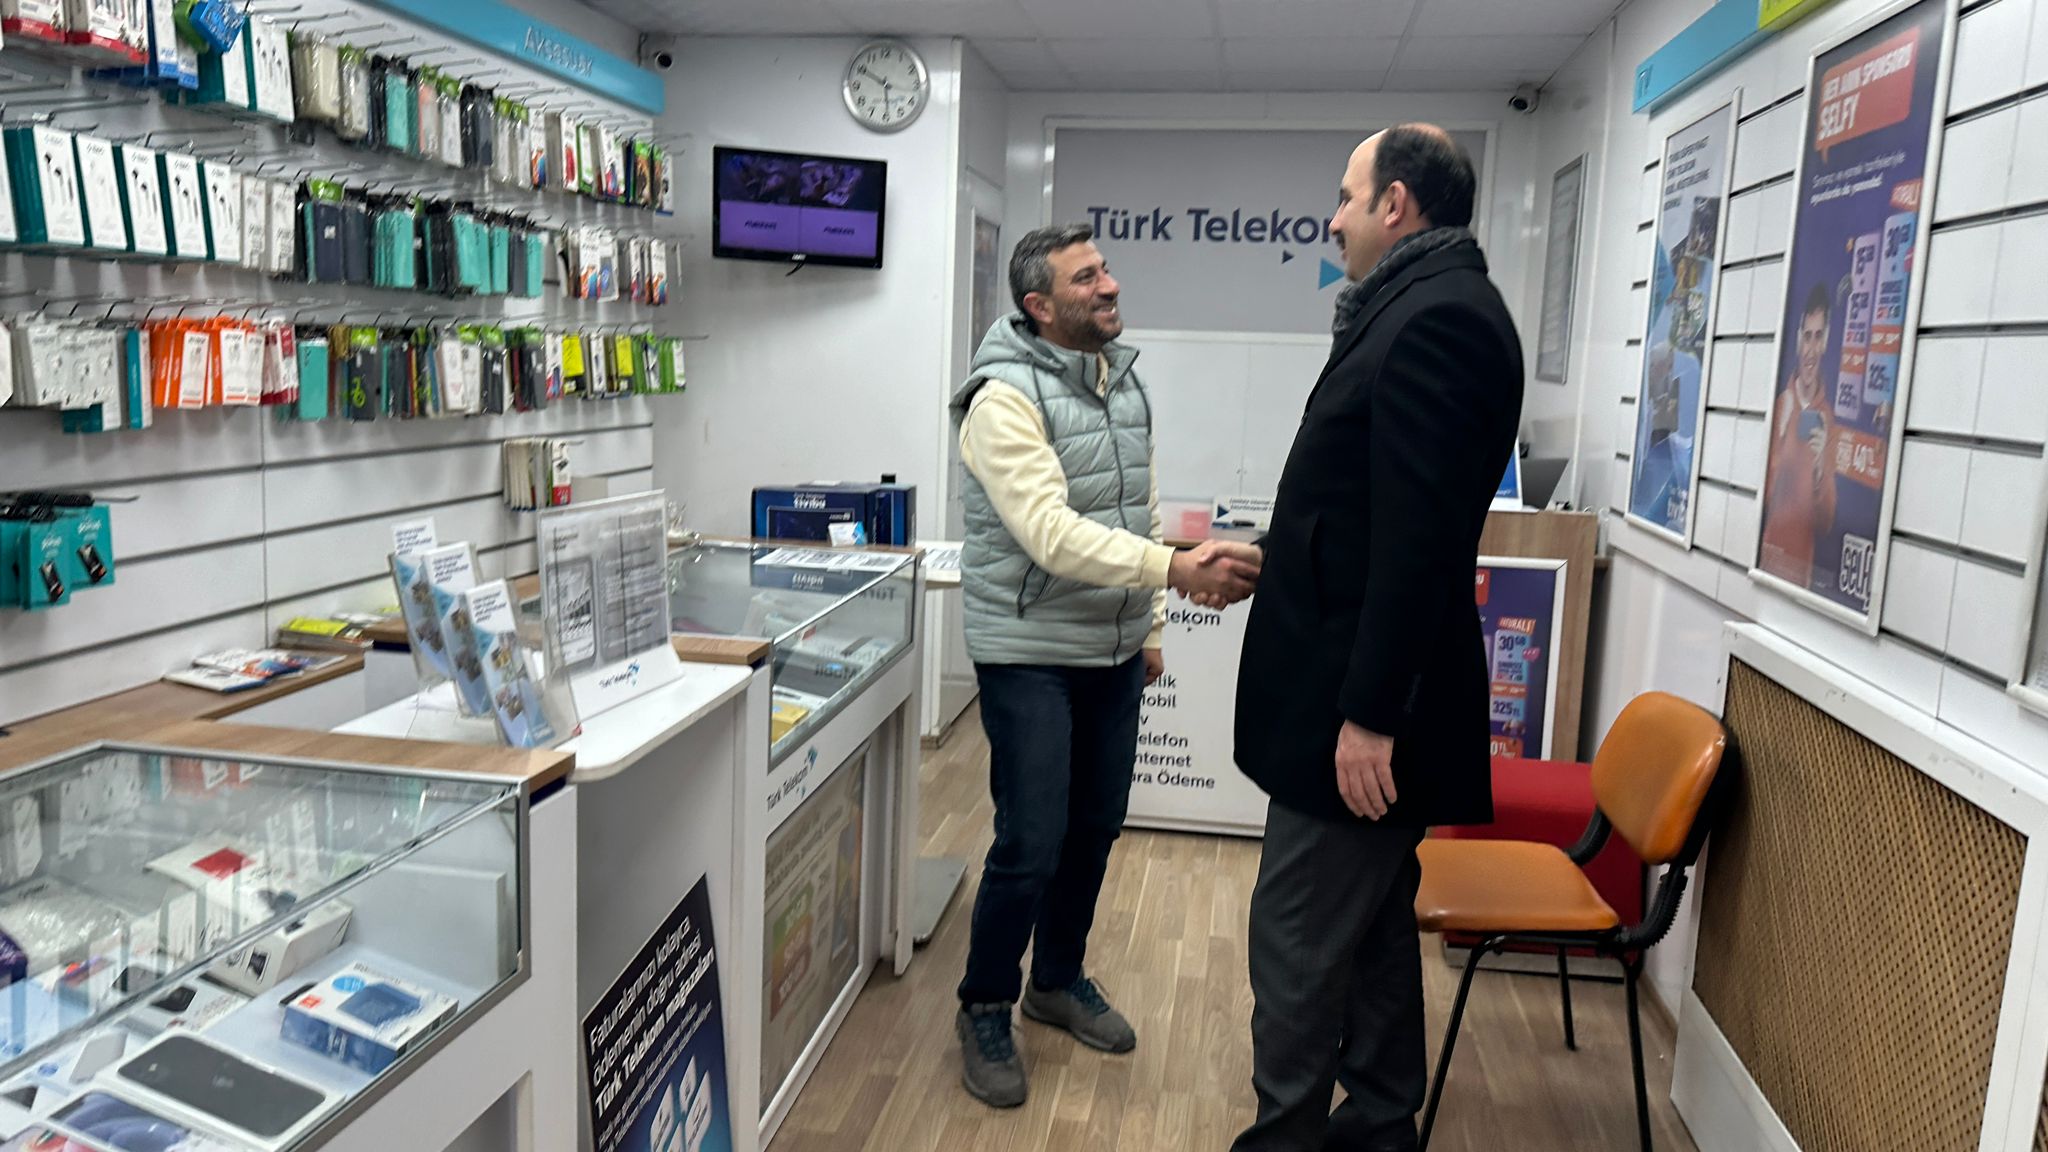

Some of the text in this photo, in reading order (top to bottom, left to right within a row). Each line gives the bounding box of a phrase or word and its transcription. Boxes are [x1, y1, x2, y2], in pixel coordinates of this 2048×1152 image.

[1817, 92, 1861, 141] SELFY
[1087, 206, 1174, 241] Türk
[1165, 608, 1221, 626] lekom
[1137, 732, 1189, 748] elefon
[1134, 754, 1192, 768] nternet
[1157, 769, 1216, 789] Ödeme
[656, 915, 691, 971] kolayca
[592, 927, 701, 1087] ödemenin doğru adresi
[595, 1070, 623, 1119] Türk
[621, 1012, 665, 1080] Telekom
